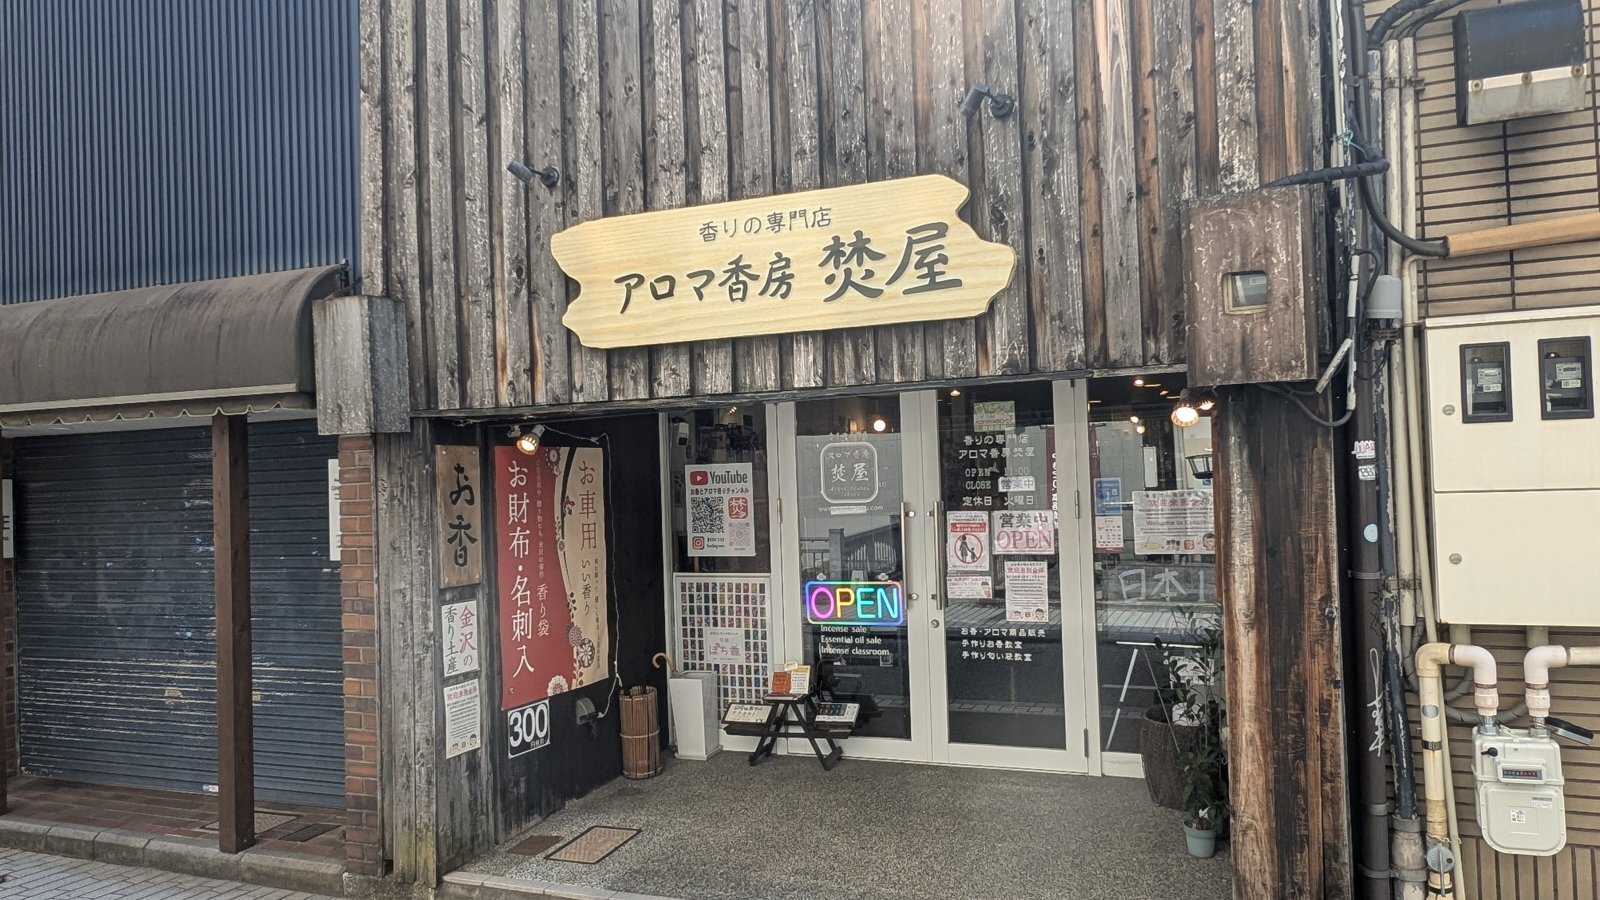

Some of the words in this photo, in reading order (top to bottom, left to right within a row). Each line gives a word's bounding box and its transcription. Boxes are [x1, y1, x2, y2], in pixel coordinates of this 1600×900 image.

[699, 207, 832, 242] 香りの専門店
[614, 251, 796, 314] アロマ香房
[818, 221, 963, 302] 焚屋
[963, 434, 1029, 446] 香りの専門店
[710, 470, 748, 484] YouTube
[831, 462, 869, 482] 焚屋
[965, 468, 991, 477] OPEN
[1004, 467, 1029, 476] 11:00
[965, 481, 991, 489] CLOSE
[579, 461, 597, 551] お車用
[963, 496, 992, 506] 定休日
[1004, 495, 1034, 506] 火曜日
[447, 463, 478, 567] お香
[1000, 512, 1048, 529] 営業中
[996, 530, 1052, 549] OPEN
[508, 460, 534, 678] お財布・名刺入
[581, 559, 592, 616] いい香り
[537, 583, 549, 637] 香り袋
[811, 587, 898, 619] OPEN
[444, 606, 460, 675] 香り土産
[459, 605, 476, 667] 金沢の
[821, 635, 853, 644] Essential
[855, 635, 865, 644] oil
[866, 636, 882, 645] sale
[962, 639, 1023, 649] 手作りお香教室
[852, 647, 890, 656] classroom
[510, 704, 547, 747] 300
